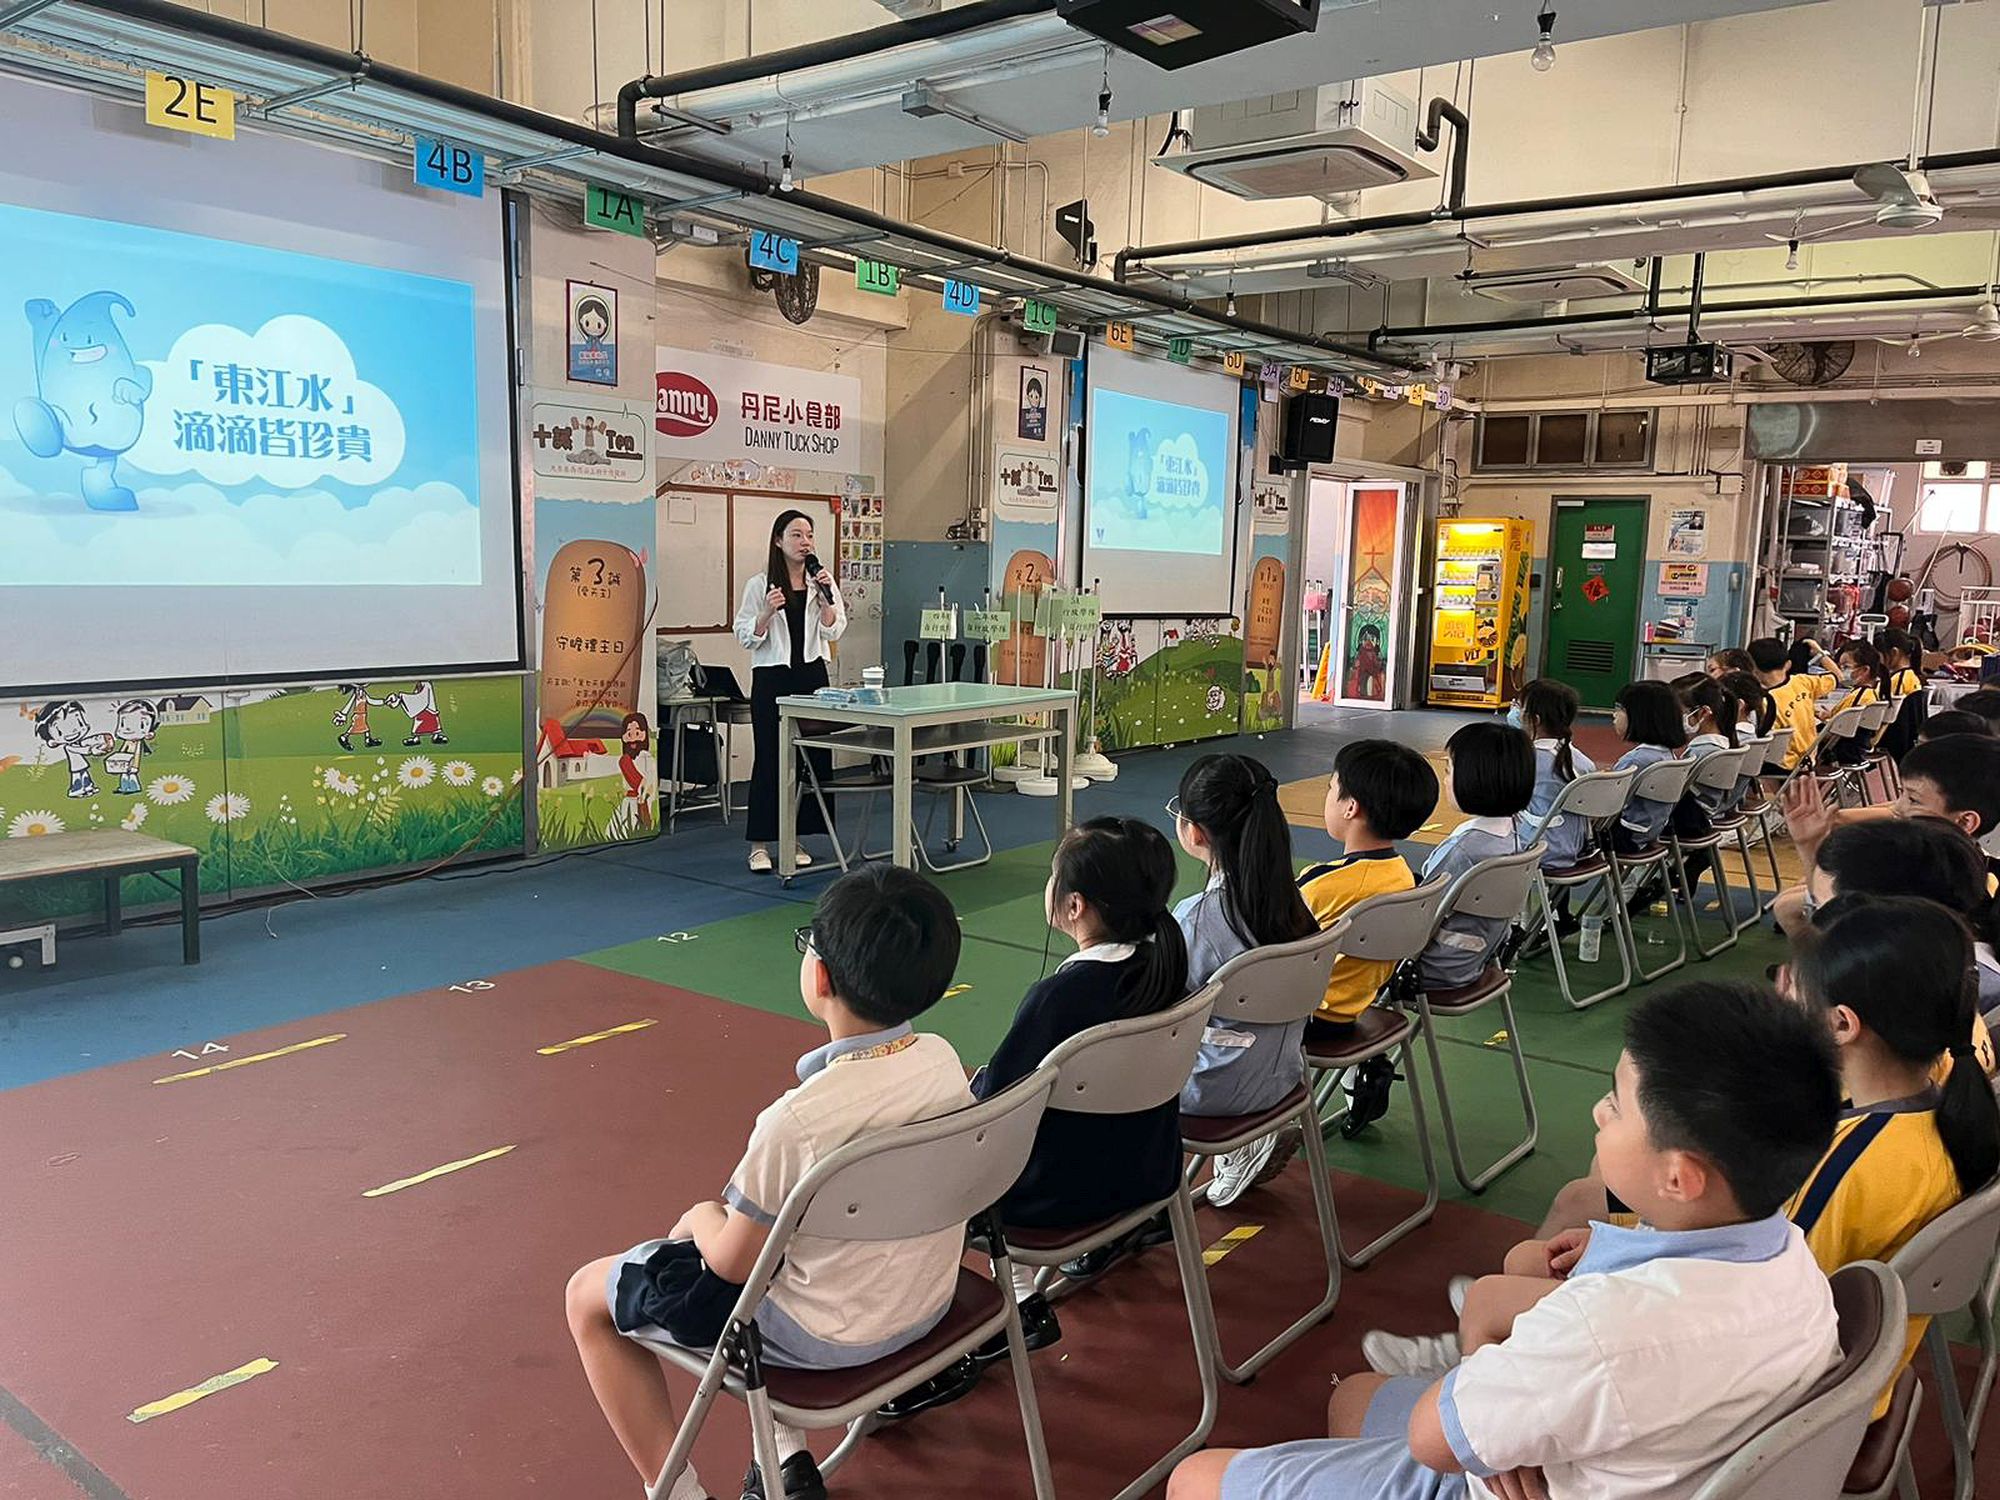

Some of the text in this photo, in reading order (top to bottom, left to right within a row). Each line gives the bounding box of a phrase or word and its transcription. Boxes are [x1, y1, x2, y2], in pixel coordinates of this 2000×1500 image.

[163, 75, 218, 125] 2E
[426, 143, 473, 184] 4B
[596, 191, 636, 224] 1A
[760, 232, 791, 264] 4C
[866, 260, 891, 287] 1B
[949, 281, 974, 307] 4D
[1030, 303, 1051, 326] 1C
[1111, 325, 1127, 343] 6E
[1172, 339, 1187, 354] 1D
[1227, 354, 1241, 368] 6D
[1263, 362, 1277, 377] 3A
[1294, 367, 1307, 384] 6C
[1329, 376, 1343, 393] 3B
[190, 361, 355, 415] 「東江水」
[656, 387, 710, 420] anny
[741, 391, 841, 430] 丹尼小食部
[173, 411, 372, 463] 滴滴皆珍貴
[606, 430, 635, 452] Ten
[745, 427, 839, 454] DANNY TUCK SHOP
[657, 930, 699, 945] 12
[448, 979, 495, 995] 13
[172, 1040, 229, 1062] 14
